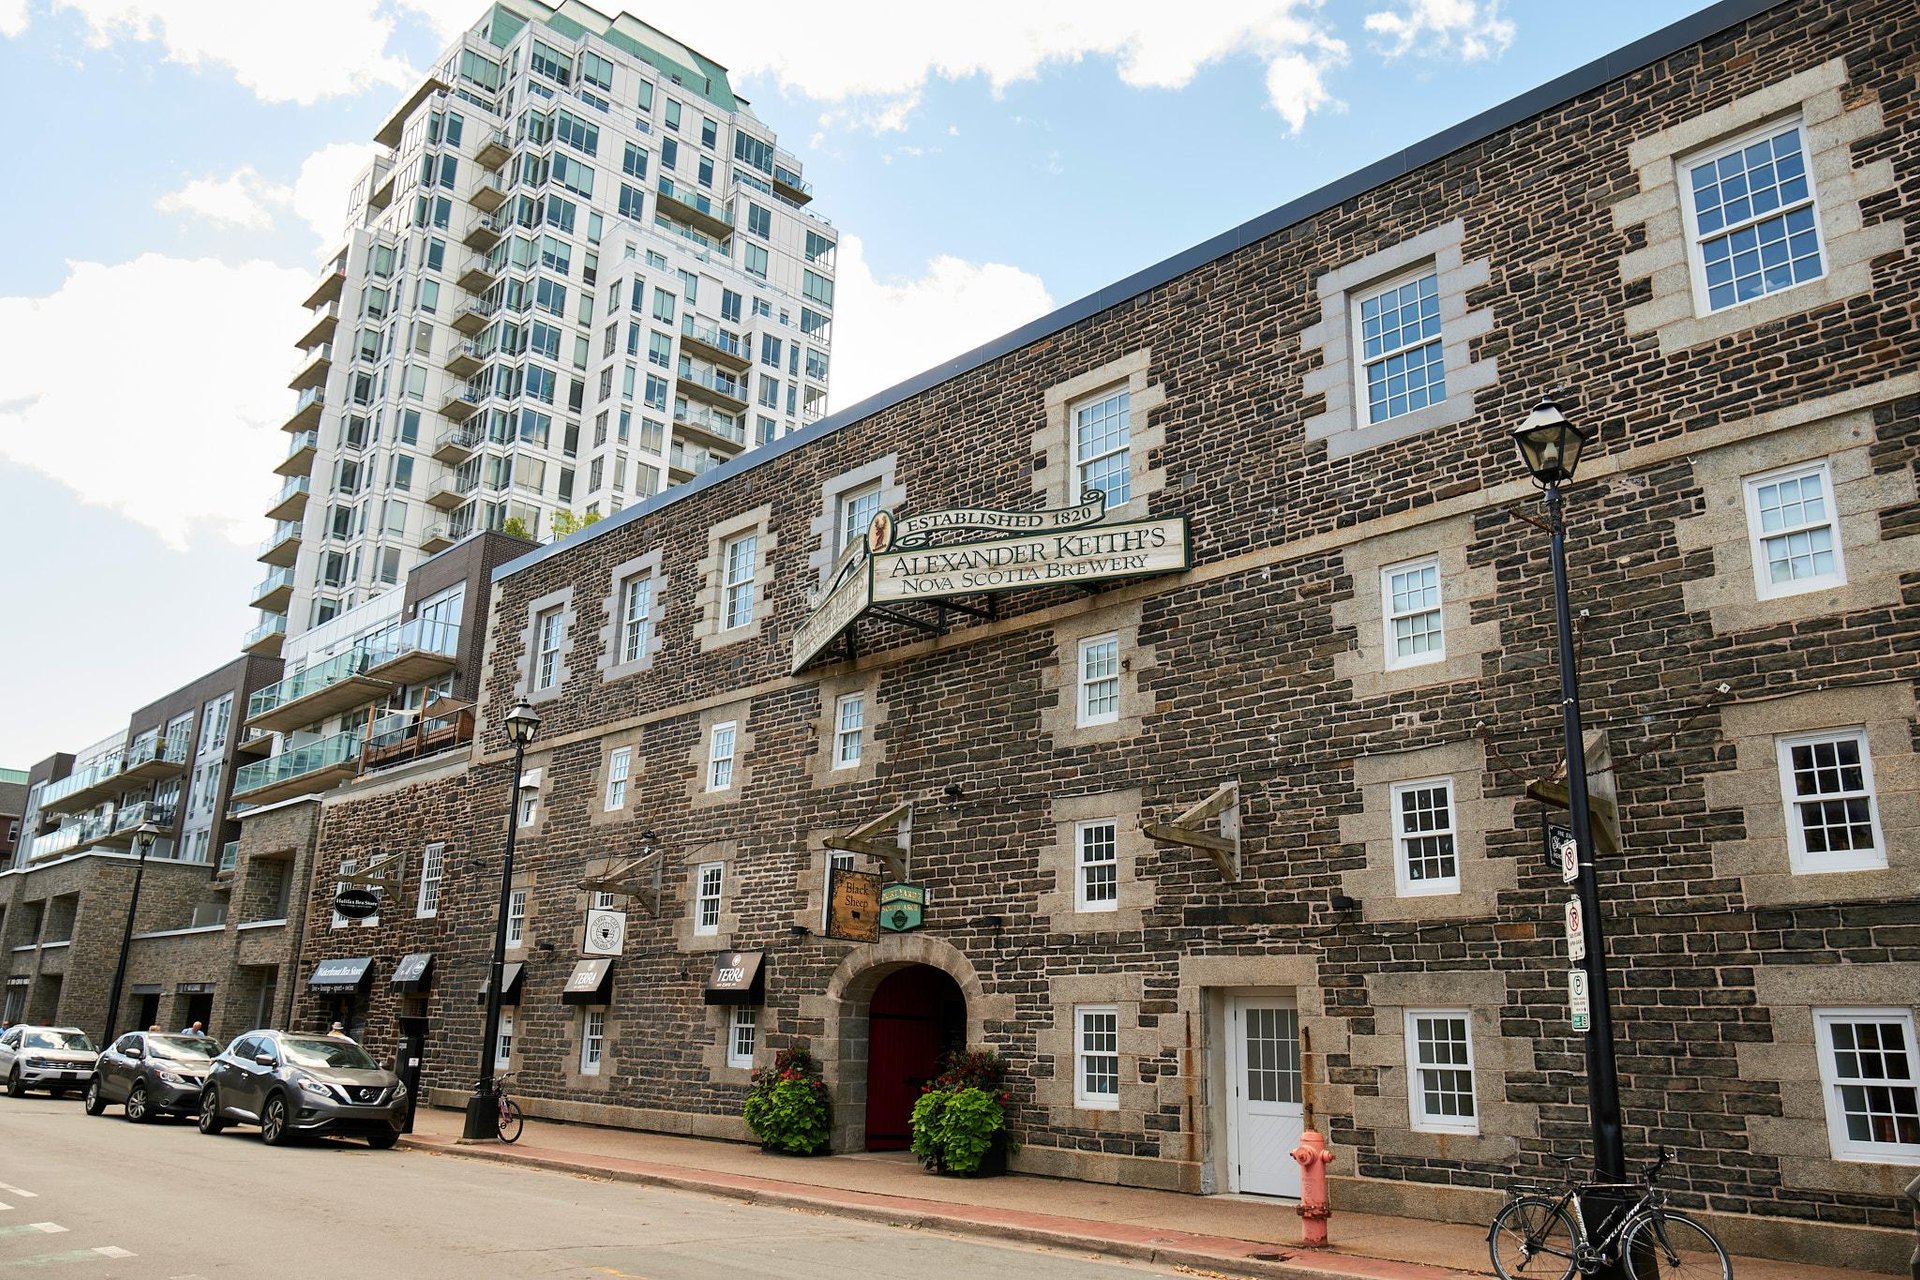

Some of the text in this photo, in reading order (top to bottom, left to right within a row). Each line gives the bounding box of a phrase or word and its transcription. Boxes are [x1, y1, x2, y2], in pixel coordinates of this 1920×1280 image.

[907, 507, 1091, 532] ESTABLISHED 1820
[892, 543, 1047, 578] ALEXANDER
[1053, 528, 1165, 559] KEITH'S
[902, 554, 1148, 595] NOVA SCOTIA BREWERY
[846, 881, 870, 896] Black
[845, 895, 869, 912] Sheep
[574, 971, 598, 985] TERRA
[717, 967, 745, 983] TERRA
